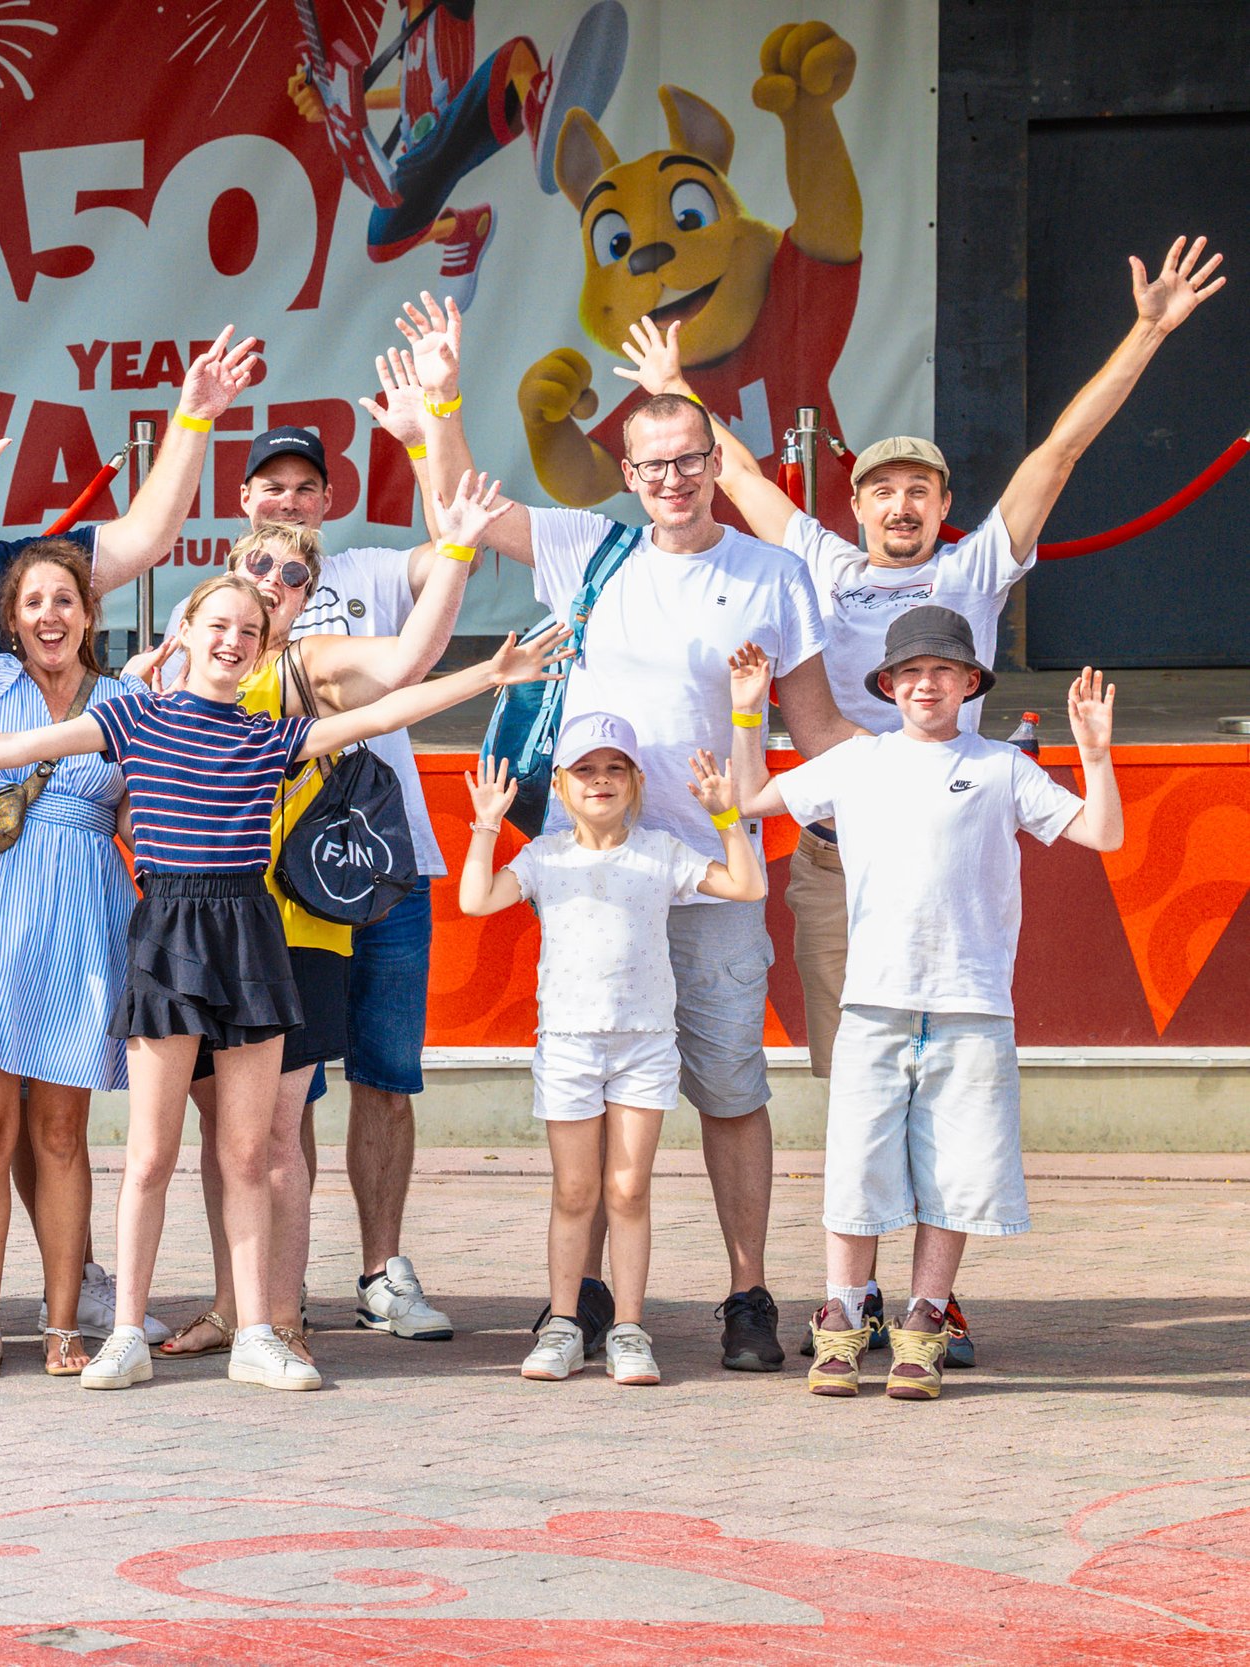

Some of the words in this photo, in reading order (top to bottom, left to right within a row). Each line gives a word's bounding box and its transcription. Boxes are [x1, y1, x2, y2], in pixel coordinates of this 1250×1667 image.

[19, 134, 317, 311] 50
[953, 780, 972, 789] NIKE
[322, 841, 374, 869] FAN
